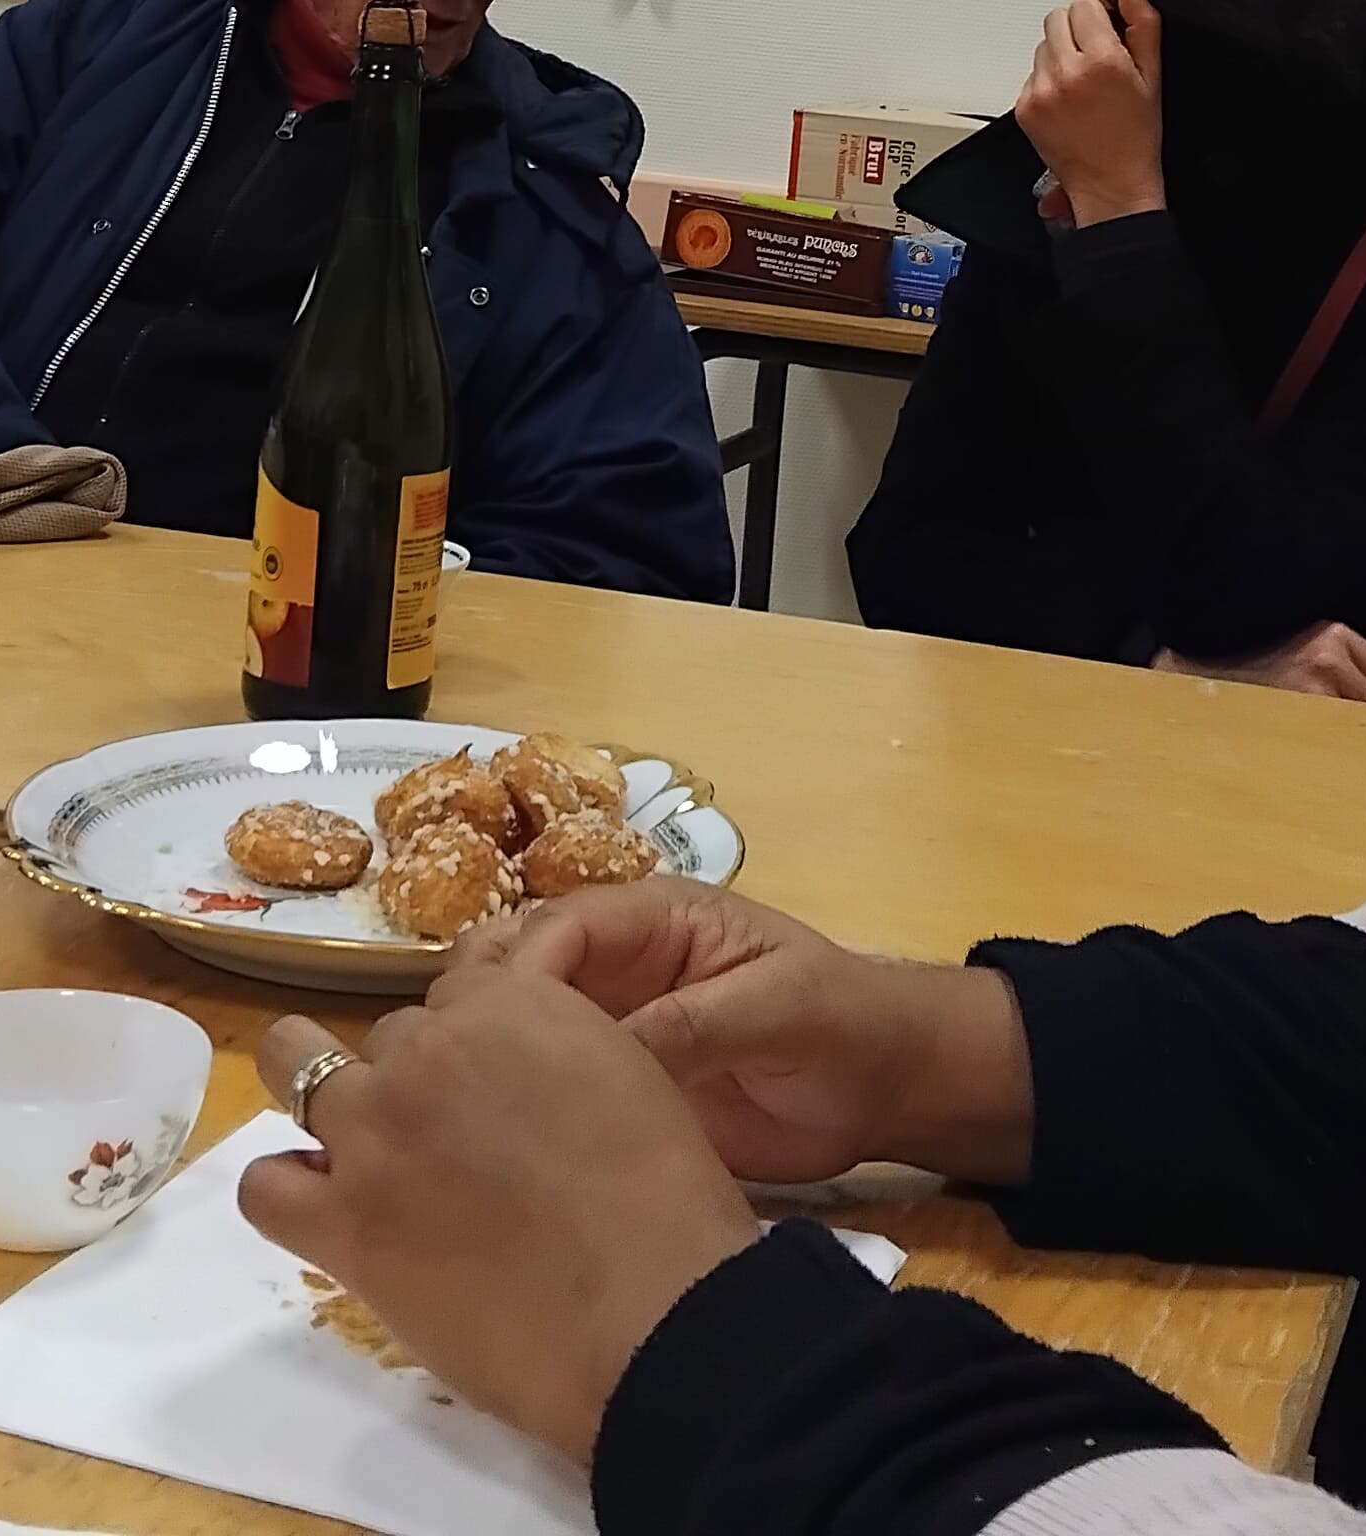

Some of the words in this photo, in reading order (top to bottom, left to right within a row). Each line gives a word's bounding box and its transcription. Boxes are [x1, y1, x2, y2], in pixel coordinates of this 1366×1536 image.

[865, 140, 885, 179] Brut
[887, 139, 903, 165] IGP
[899, 140, 916, 179] Cidre
